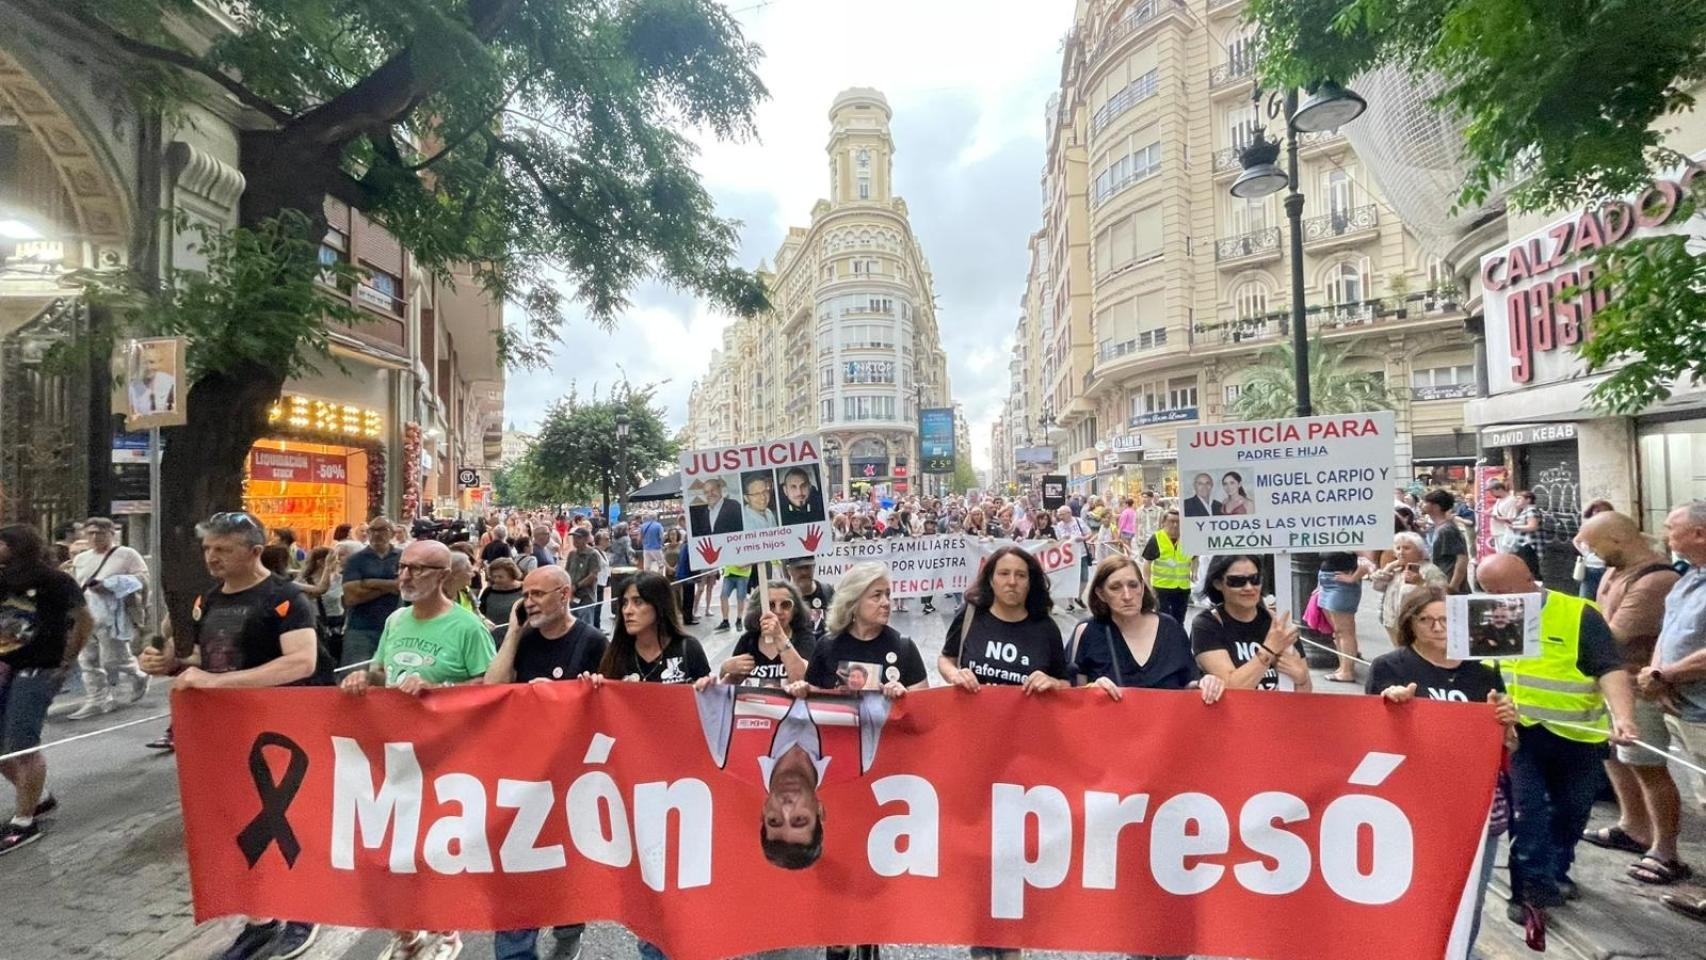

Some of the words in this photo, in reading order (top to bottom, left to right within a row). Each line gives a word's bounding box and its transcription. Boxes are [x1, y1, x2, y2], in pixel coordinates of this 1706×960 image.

[1308, 419, 1379, 440] PARA
[1493, 431, 1524, 445] DAVID
[1532, 425, 1574, 441] KEBAB
[685, 440, 818, 475] JUSTICIA
[1237, 448, 1281, 460] PADRE
[1285, 448, 1293, 457] E
[1298, 445, 1328, 457] HIJA
[1256, 472, 1312, 487] MIGUEL
[1316, 468, 1375, 484] CARPIO
[1379, 467, 1389, 480] Y
[1271, 492, 1311, 505] SARA
[1315, 488, 1374, 503] CARPIO
[1195, 521, 1205, 531] Y
[1209, 519, 1261, 531] TODAS
[1266, 517, 1296, 529] LAS
[1301, 514, 1377, 528] VICTIMAS
[726, 534, 742, 543] por
[745, 532, 757, 540] mi
[759, 527, 792, 539] marido
[1207, 532, 1273, 548] MAZÓN
[1289, 528, 1364, 546] PRISIÓN
[736, 546, 742, 554] y
[763, 540, 786, 551] hijos
[890, 538, 966, 553] FAMILIARES
[818, 566, 842, 576] HAN
[892, 561, 915, 571] POR
[917, 557, 966, 569] VUESTRA
[985, 640, 1017, 663] NO
[1020, 655, 1029, 666] a
[330, 732, 713, 892] Mazón
[867, 773, 939, 878] a
[990, 752, 1414, 919] presó
